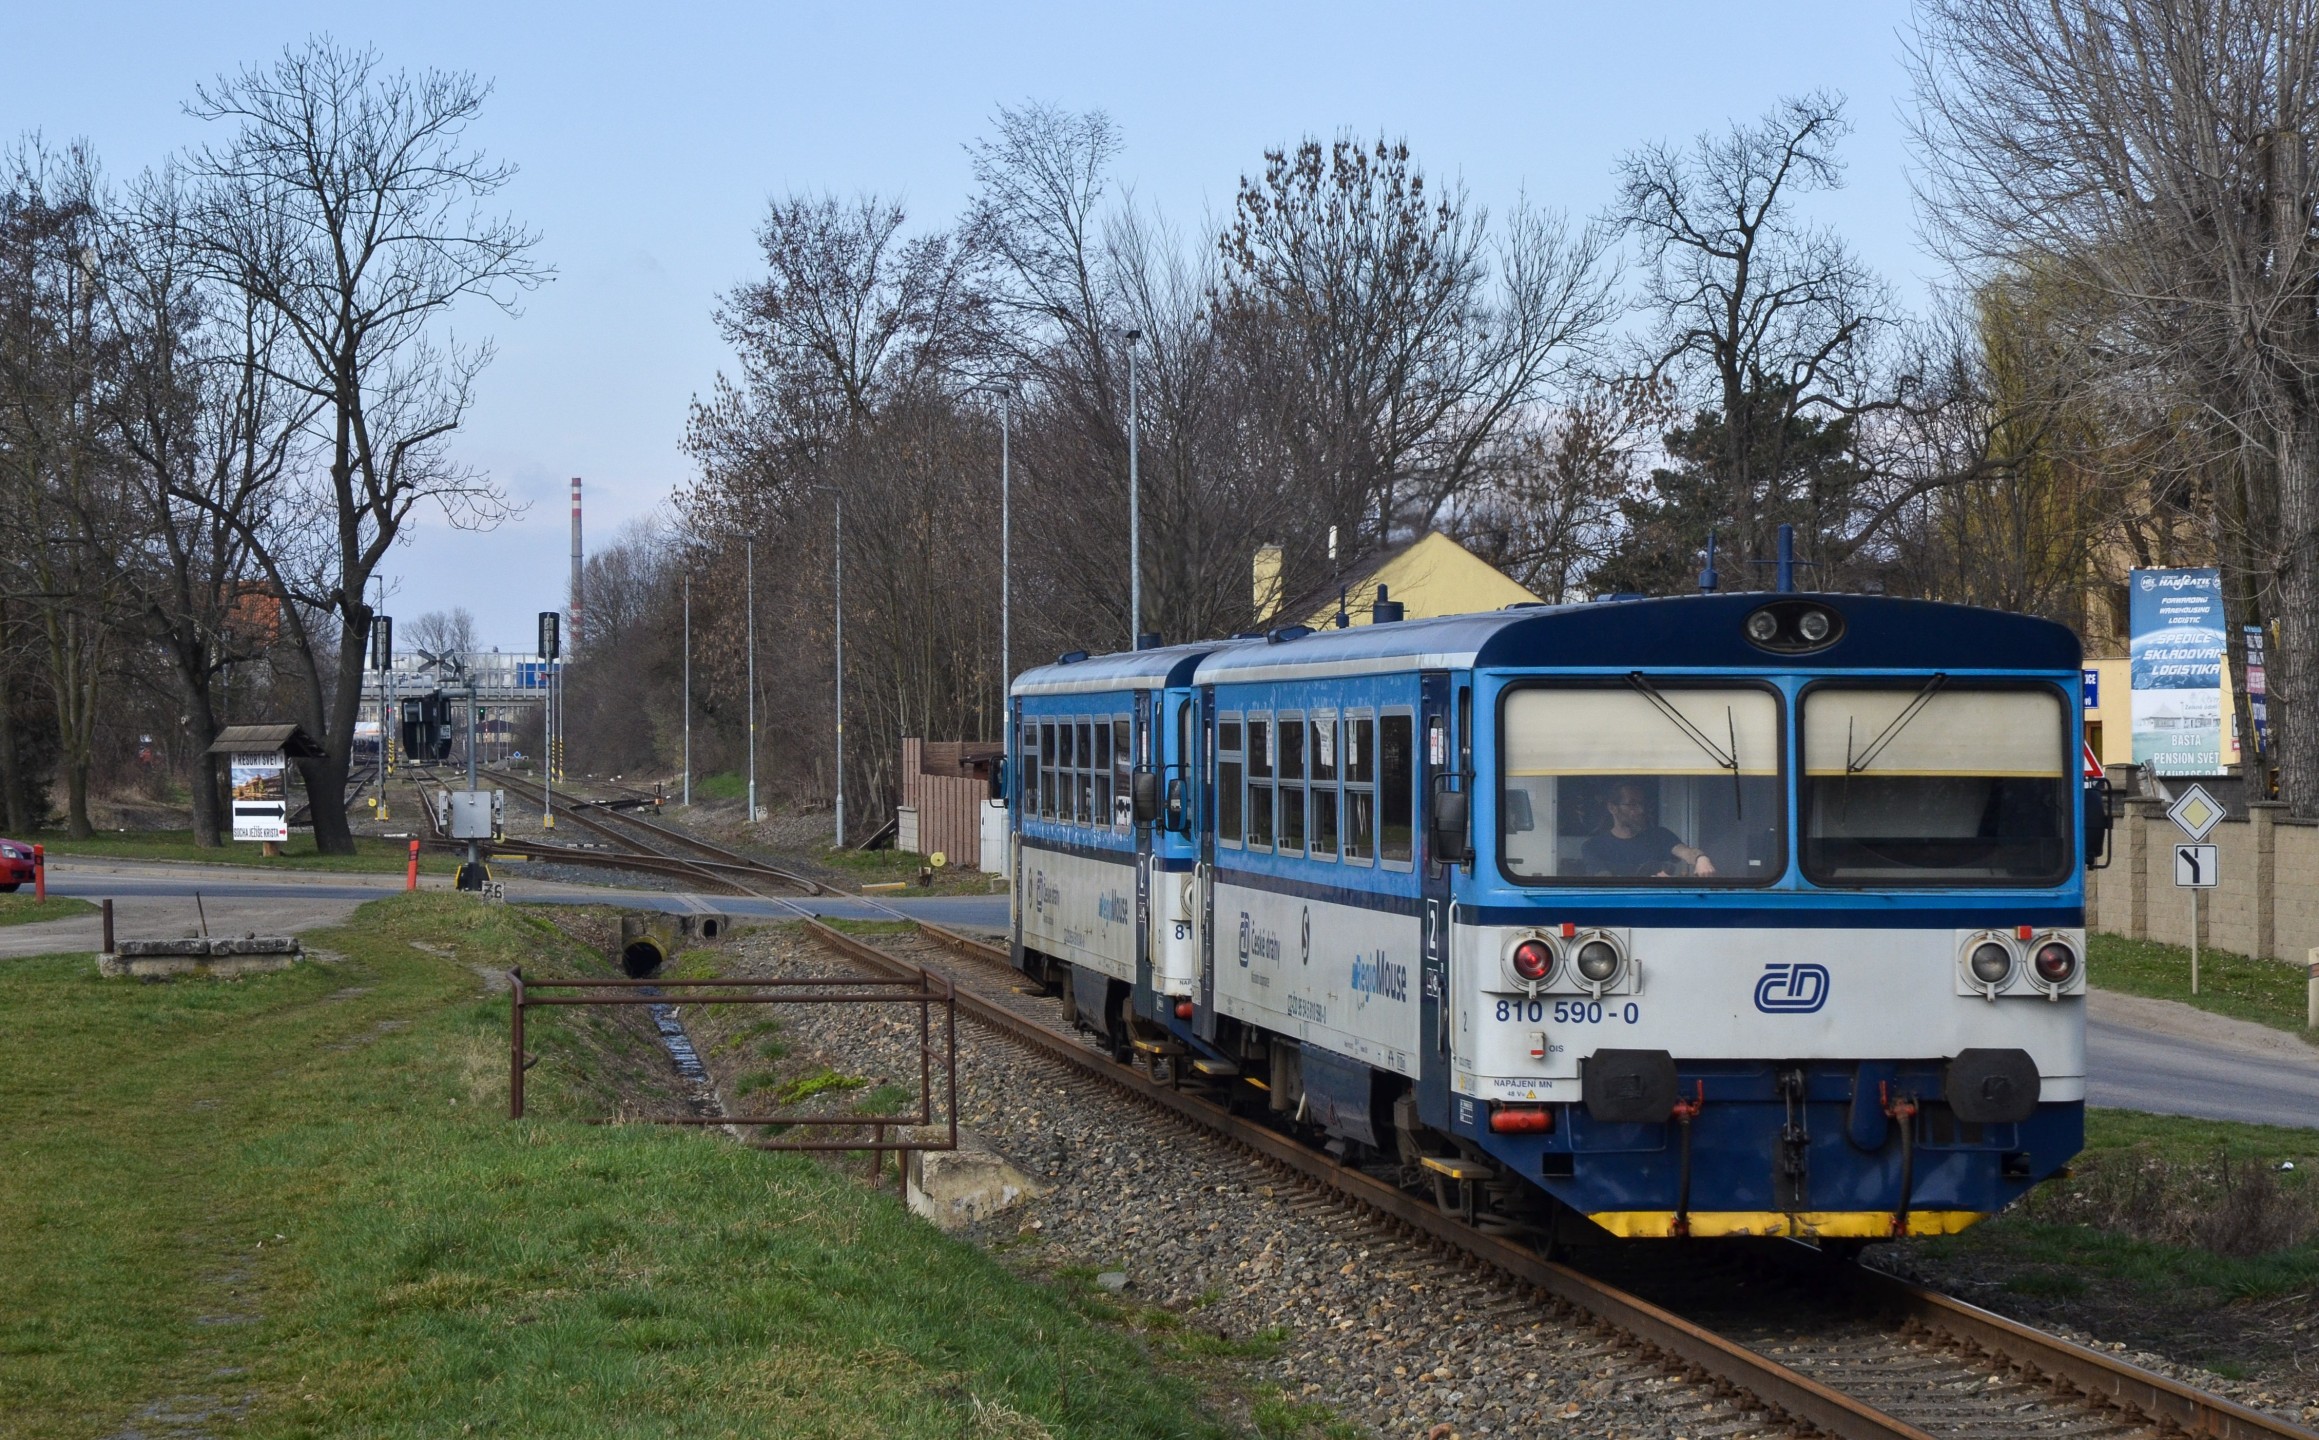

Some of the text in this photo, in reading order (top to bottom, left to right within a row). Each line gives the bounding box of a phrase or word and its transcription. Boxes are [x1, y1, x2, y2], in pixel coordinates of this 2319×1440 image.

[2159, 575, 2212, 590] HANSEATIC
[2157, 633, 2212, 644] SPEDICE
[2143, 646, 2222, 660] SKLADOVÁN
[2151, 664, 2221, 676] LOGISTIKA
[237, 754, 261, 766] RESORT
[2153, 751, 2195, 765] PENSION
[233, 827, 249, 838] SOCHA
[264, 827, 280, 838] KRISTA
[1429, 909, 1436, 950] 2
[1251, 919, 1281, 970] České dráhy
[1352, 949, 1407, 1003] RegioMouse
[1495, 1000, 1543, 1022] 810
[1549, 1045, 1564, 1053] OIS
[1493, 1078, 1537, 1088] NAPÁJENÍ
